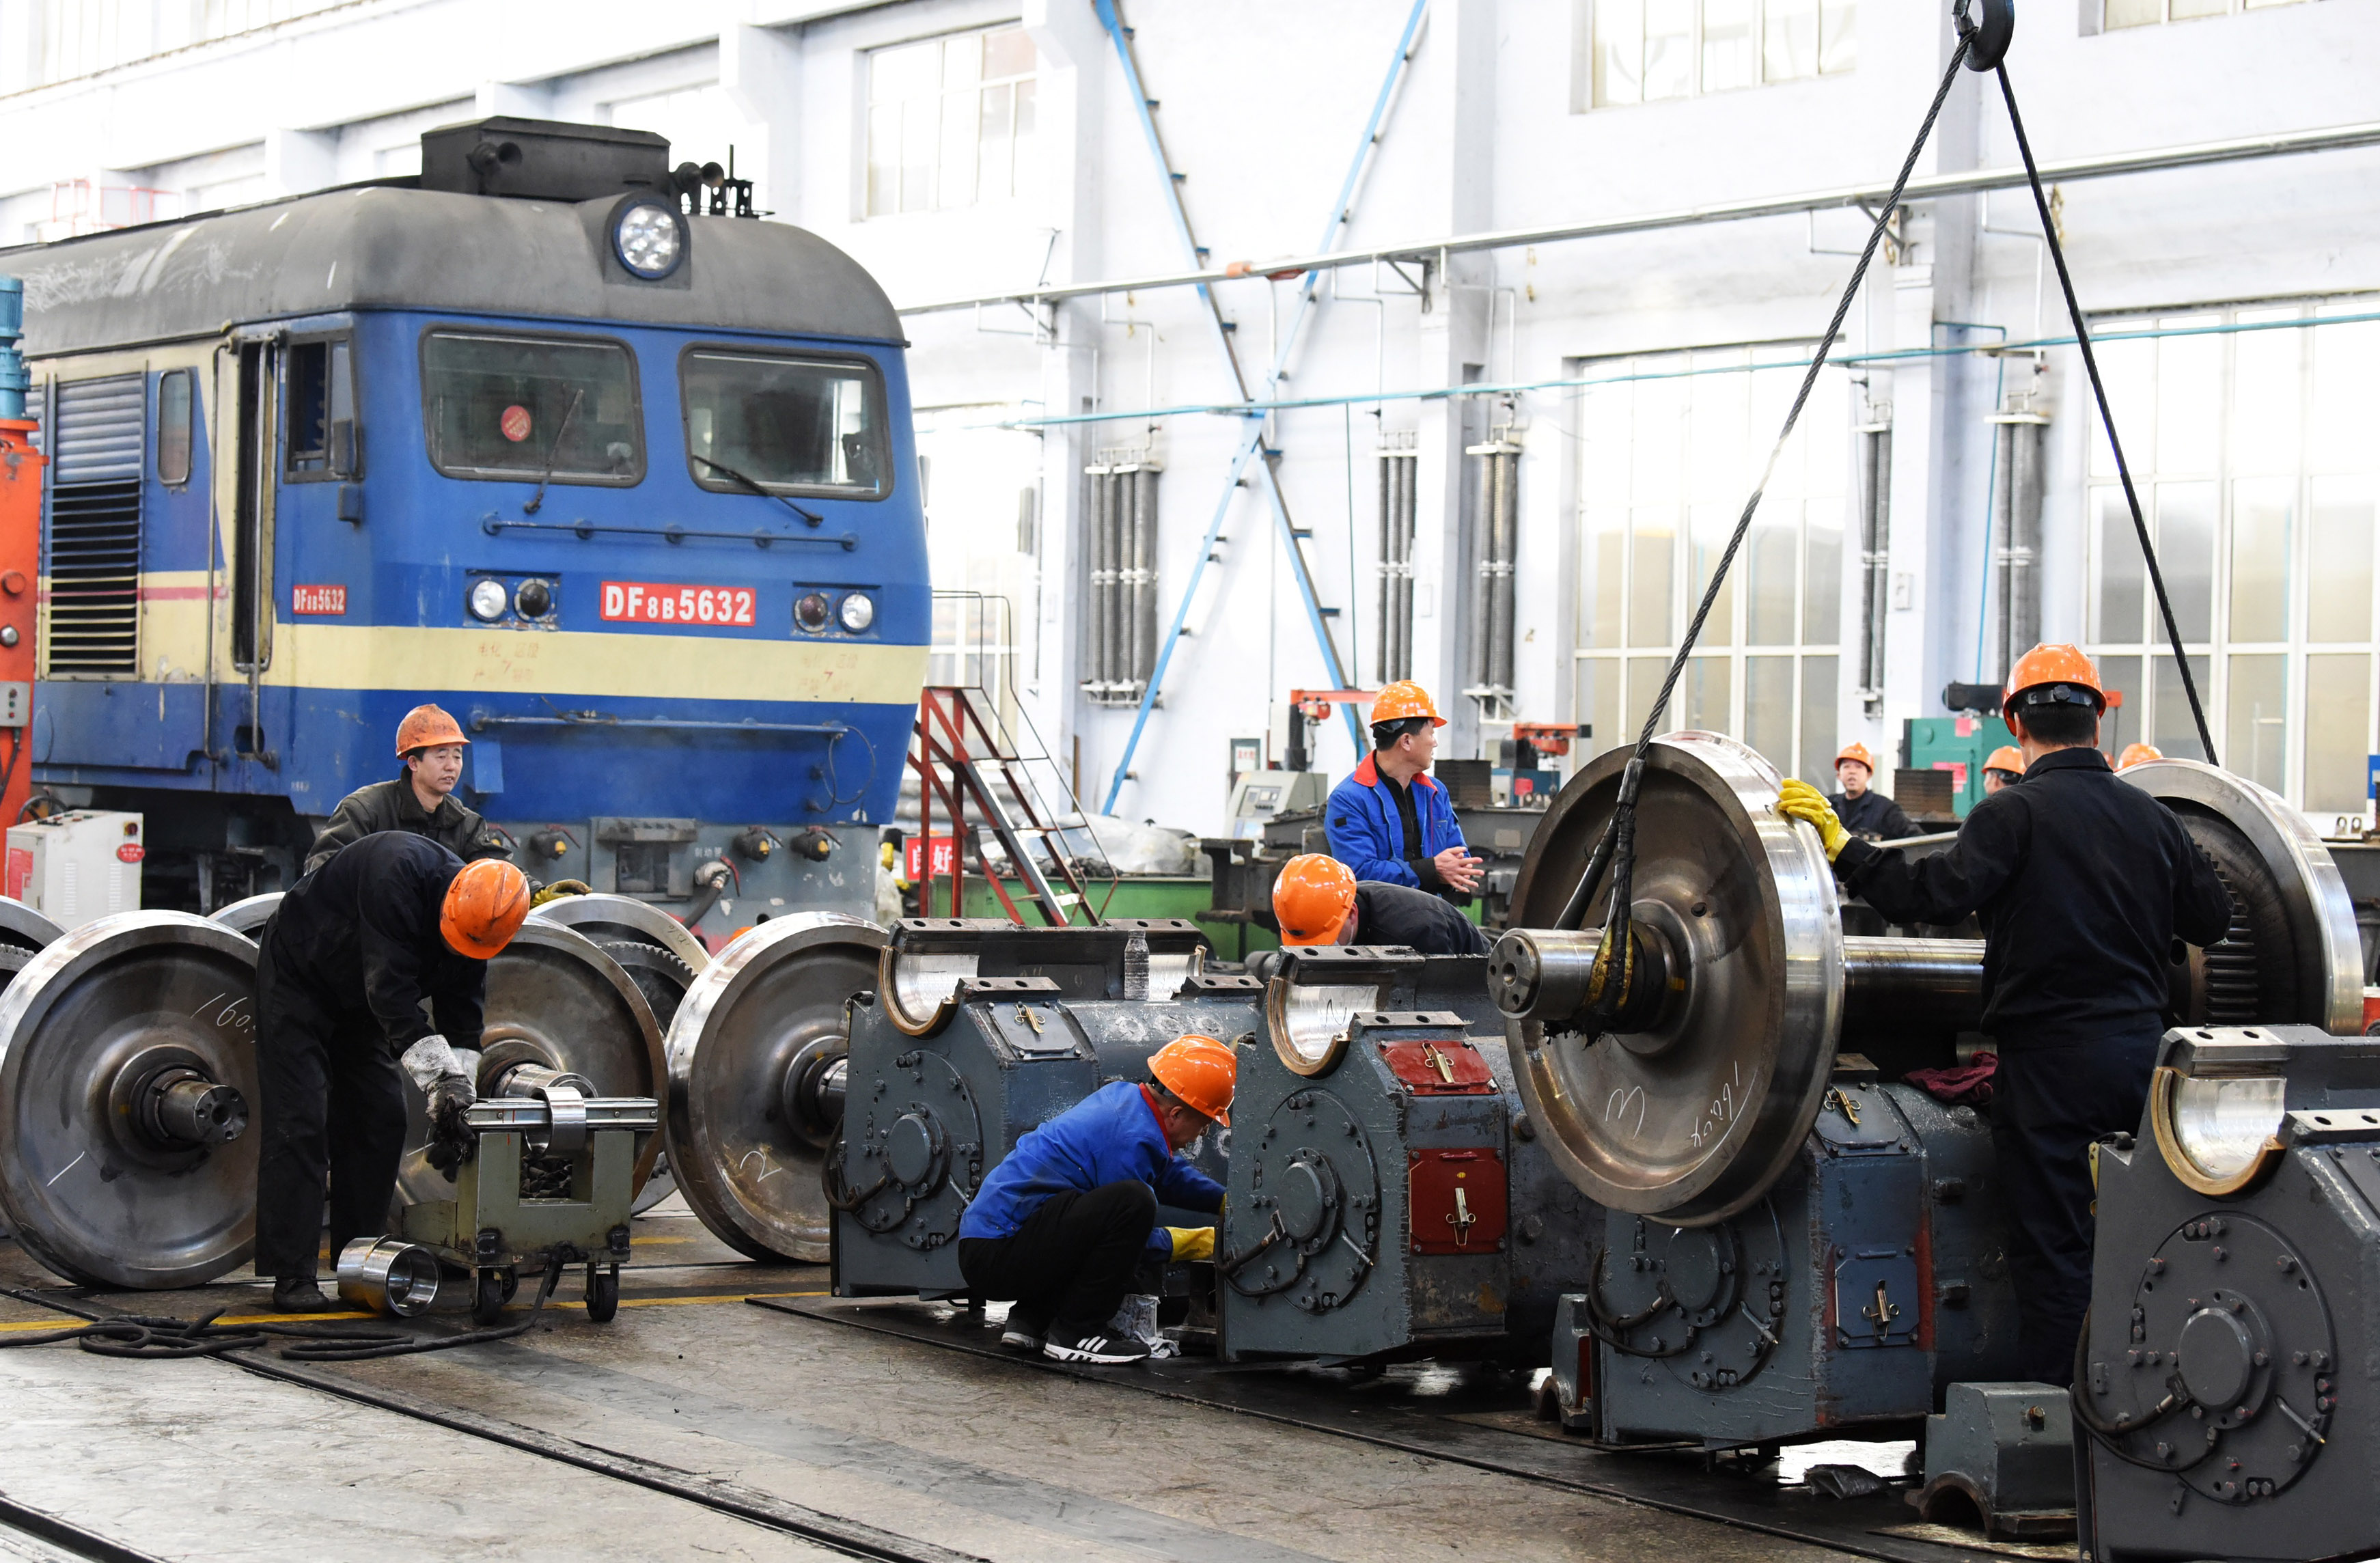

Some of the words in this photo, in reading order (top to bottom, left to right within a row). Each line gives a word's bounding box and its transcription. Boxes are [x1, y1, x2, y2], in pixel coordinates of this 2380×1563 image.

[293, 588, 345, 611] DF8B5632
[605, 585, 751, 623] DF8B5632
[739, 1150, 783, 1183] 2
